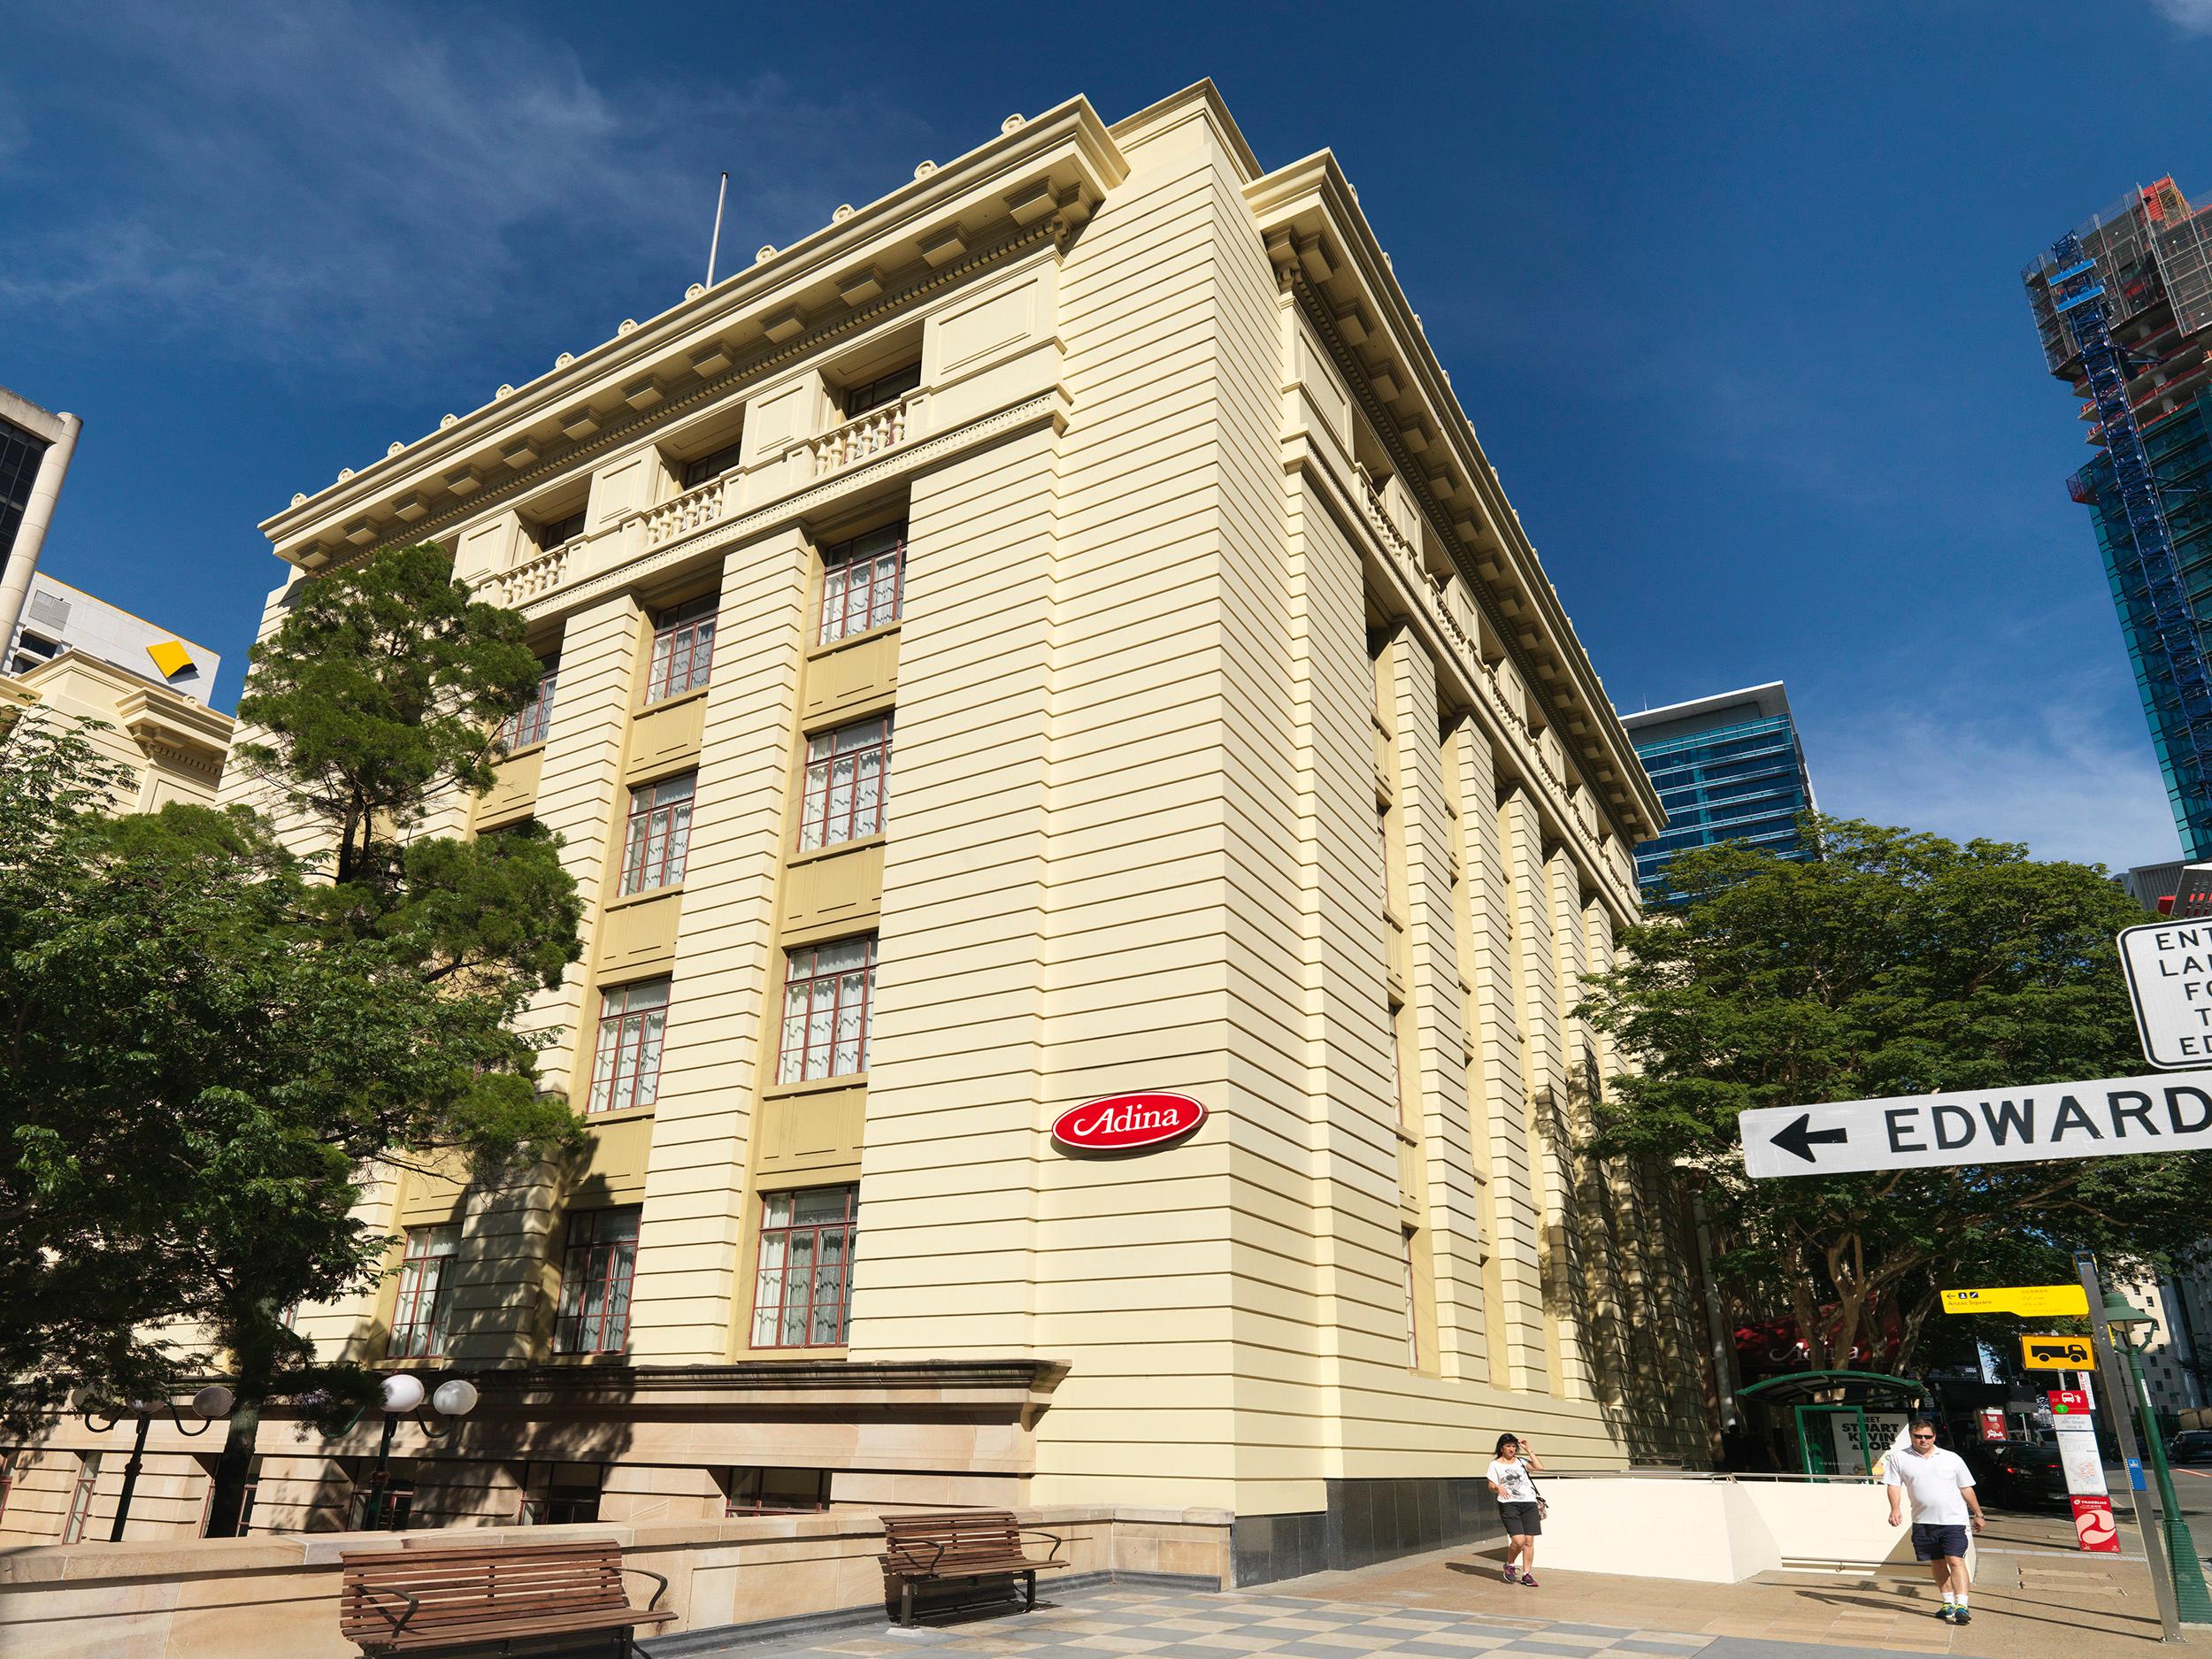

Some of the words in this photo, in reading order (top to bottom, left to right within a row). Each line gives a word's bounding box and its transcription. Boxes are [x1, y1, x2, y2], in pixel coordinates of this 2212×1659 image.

[1073, 1103, 1179, 1136] Adina
[1885, 1087, 2212, 1153] EDWARD
[1770, 1341, 1861, 1362] Aia
